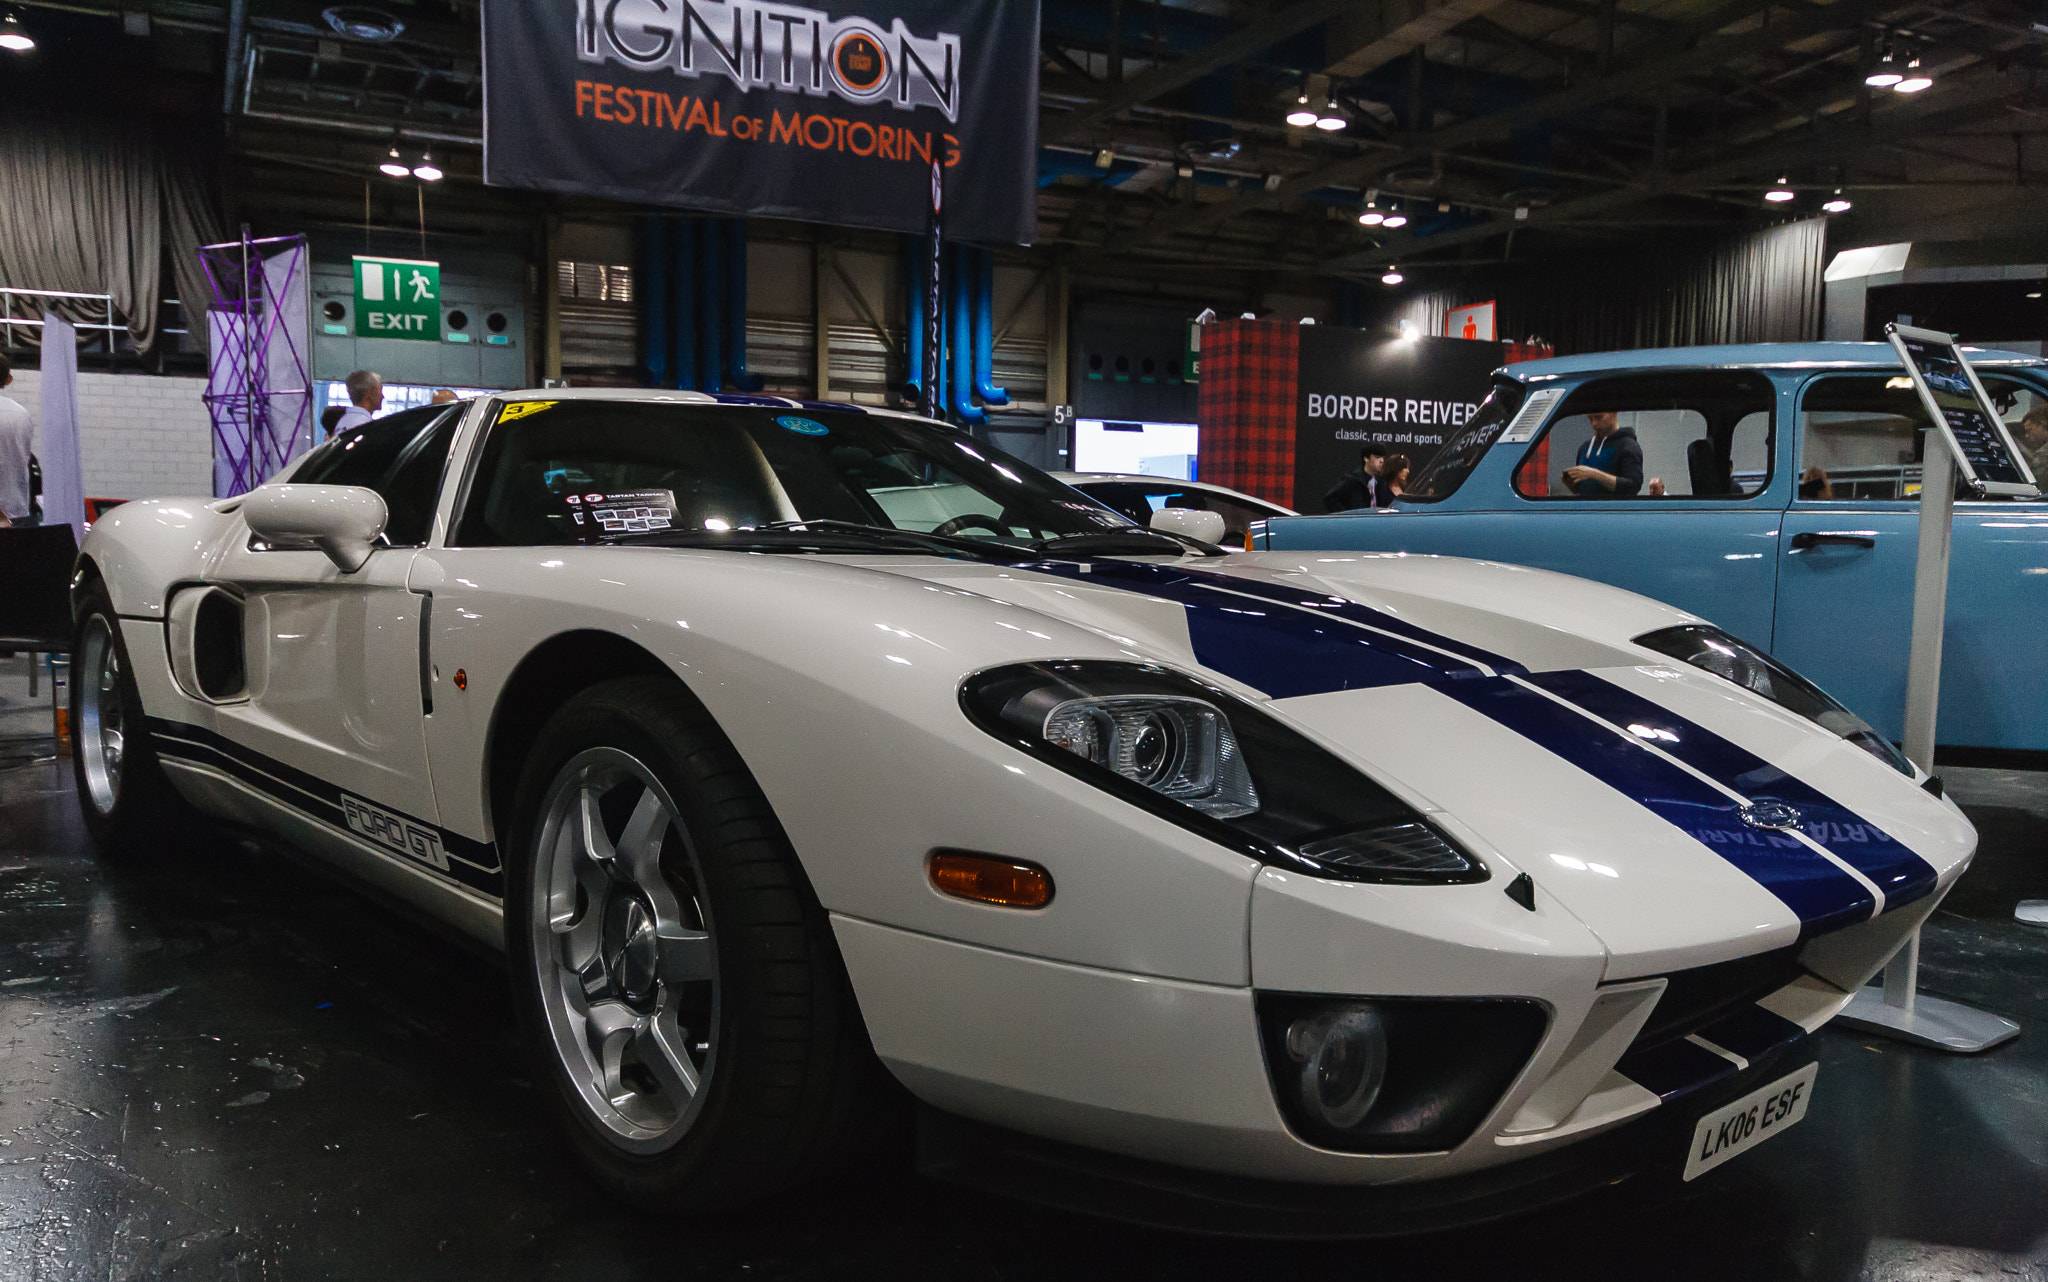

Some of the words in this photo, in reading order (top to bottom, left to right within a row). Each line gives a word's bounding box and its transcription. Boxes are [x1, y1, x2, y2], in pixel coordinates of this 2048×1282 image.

[577, 0, 960, 122] IGNITION
[575, 80, 728, 137] FESTIVAL
[731, 115, 763, 141] OF
[368, 312, 428, 331] EXIT
[1308, 393, 1398, 422] BORDER
[1404, 399, 1477, 426] REIVER
[1335, 428, 1370, 442] classic,
[1372, 432, 1392, 442] race
[1395, 431, 1412, 443] and
[1414, 433, 1443, 446] sports
[344, 798, 406, 848] FORD
[405, 824, 439, 862] GT
[1701, 1104, 1759, 1161] LK06
[1760, 1082, 1805, 1130] ESF
